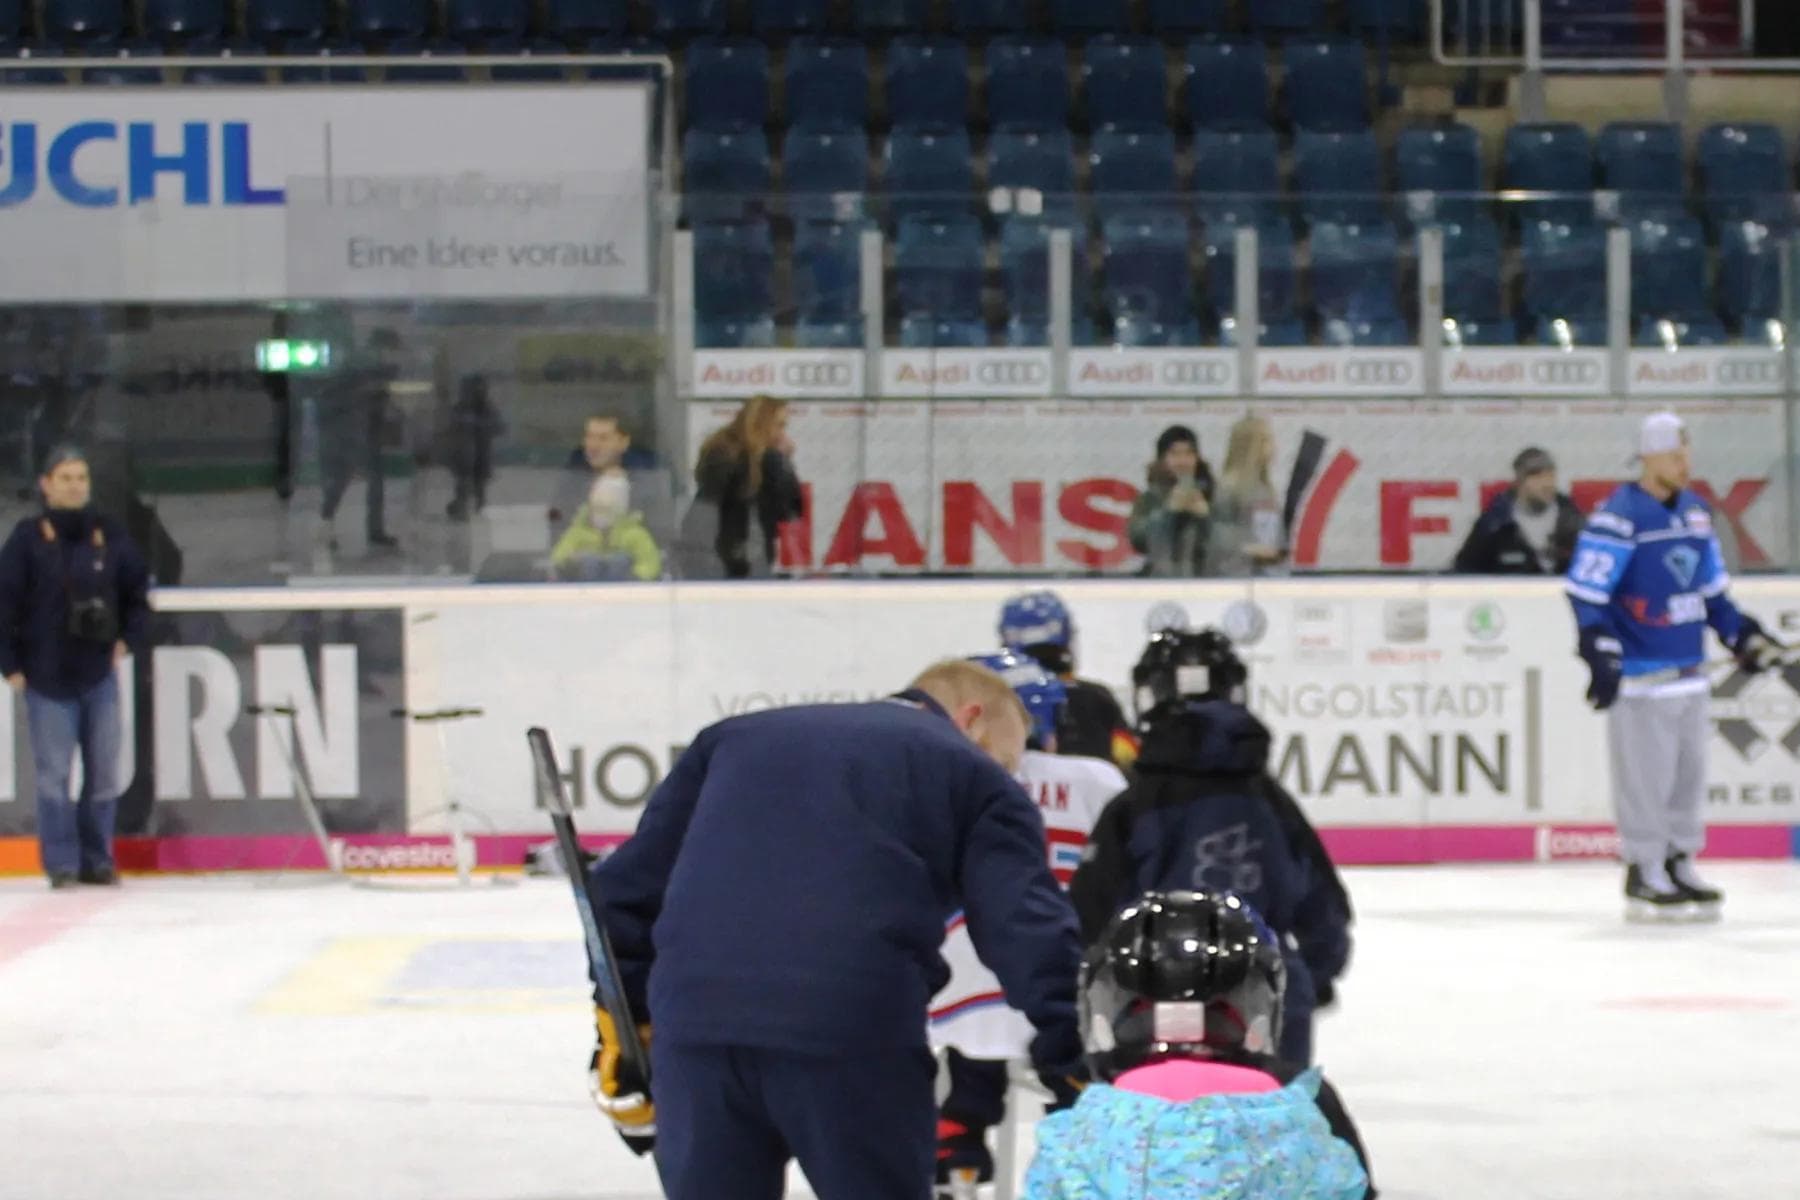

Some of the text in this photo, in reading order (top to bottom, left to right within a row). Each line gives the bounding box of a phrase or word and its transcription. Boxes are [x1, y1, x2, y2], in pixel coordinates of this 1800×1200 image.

[347, 237, 418, 269] Eine
[426, 236, 499, 268] Idee
[702, 363, 775, 385] Audi
[896, 362, 970, 384] Audi
[1080, 361, 1153, 384] Audi
[1263, 361, 1336, 384] Audi
[1450, 361, 1523, 383] Audi
[1637, 361, 1709, 383] Audi
